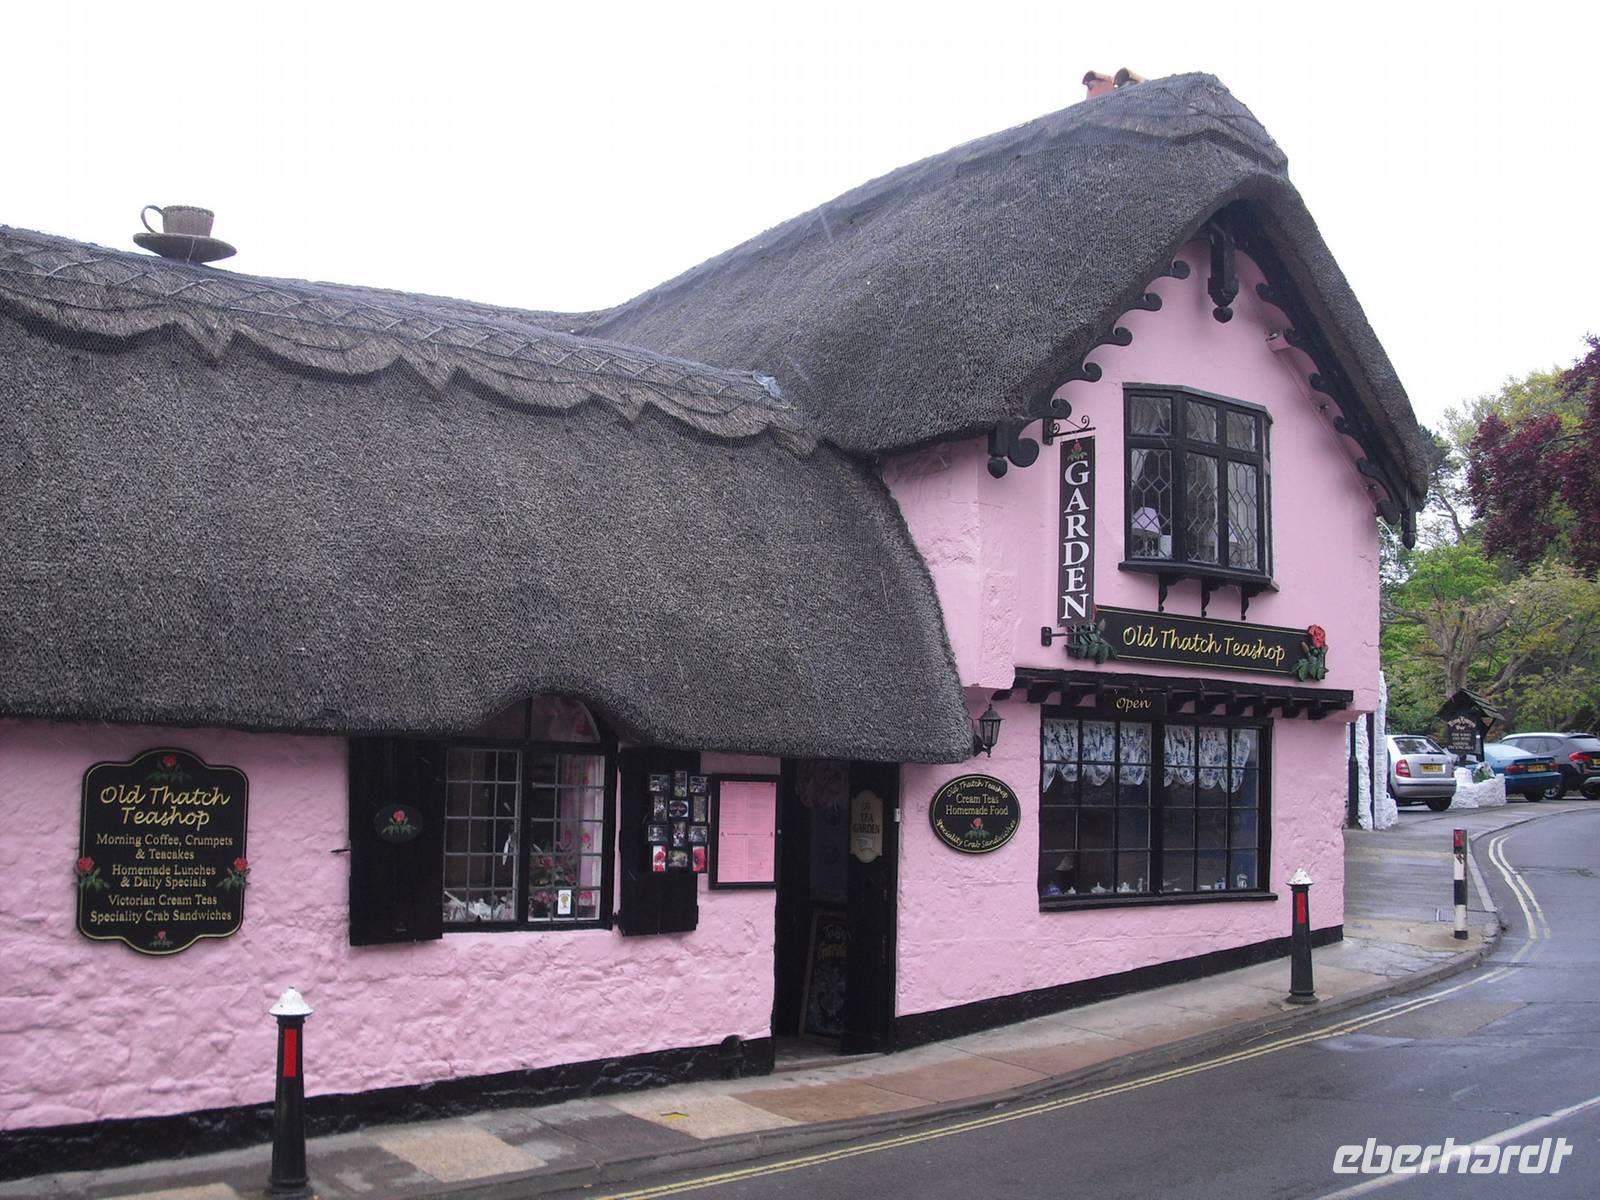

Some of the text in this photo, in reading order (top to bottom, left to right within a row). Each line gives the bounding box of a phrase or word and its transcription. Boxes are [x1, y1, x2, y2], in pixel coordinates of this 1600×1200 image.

[1061, 460, 1090, 620] GARDEN
[1122, 625, 1286, 667] Old Thatch Teashop
[1116, 697, 1151, 712] Open
[960, 779, 984, 789] Thatch
[100, 784, 231, 806] Old Thatch
[955, 793, 1000, 804] Cream Teas
[945, 805, 1009, 816] Homemade Food
[121, 806, 210, 832] Teashop
[860, 812, 874, 823] TEA
[852, 823, 881, 835] GARDEN
[96, 833, 233, 848] Morning Coffee, Crumpets
[963, 840, 981, 848] Crab
[135, 848, 195, 860] & Teacakes
[112, 864, 216, 876] Homemade Lunches
[120, 876, 207, 890] & Daily Specials
[108, 894, 217, 906] Victorian Cream Teas
[90, 909, 232, 925] Speciality Crab Sandwiches
